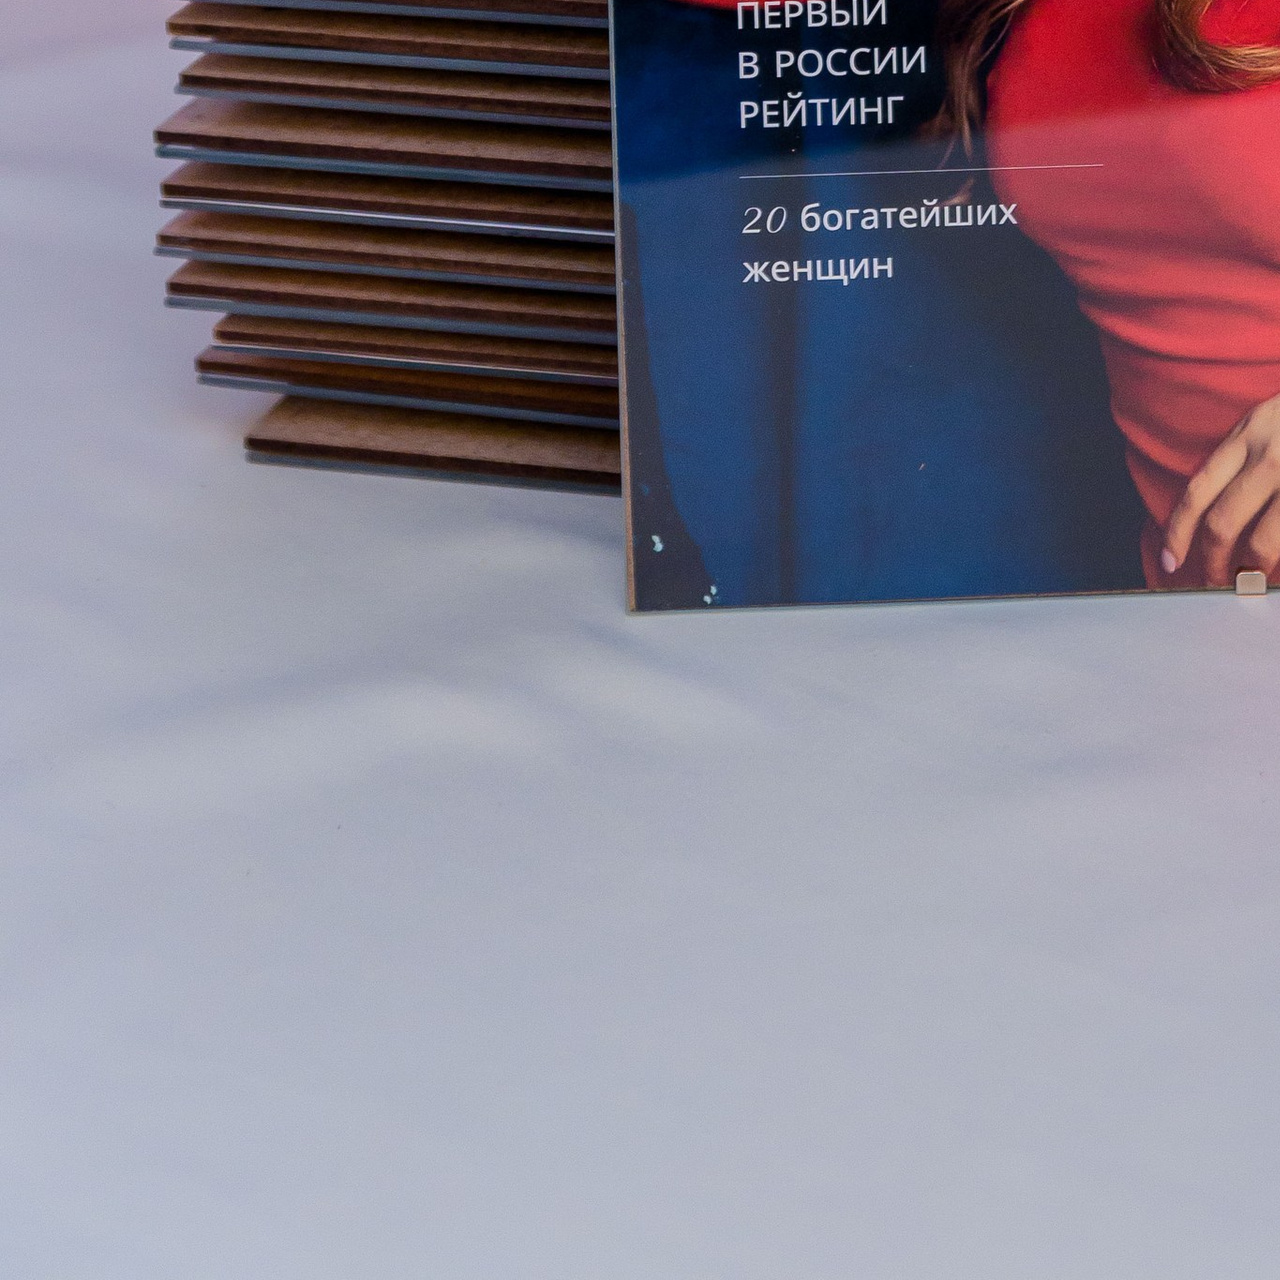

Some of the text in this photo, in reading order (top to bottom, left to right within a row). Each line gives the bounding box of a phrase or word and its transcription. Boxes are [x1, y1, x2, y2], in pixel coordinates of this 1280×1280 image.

[738, 46, 928, 79] В РОССИИ
[739, 91, 904, 129] РЕЙТИНГ
[741, 198, 1018, 234] 20 богатейших
[742, 257, 894, 286] женщин
